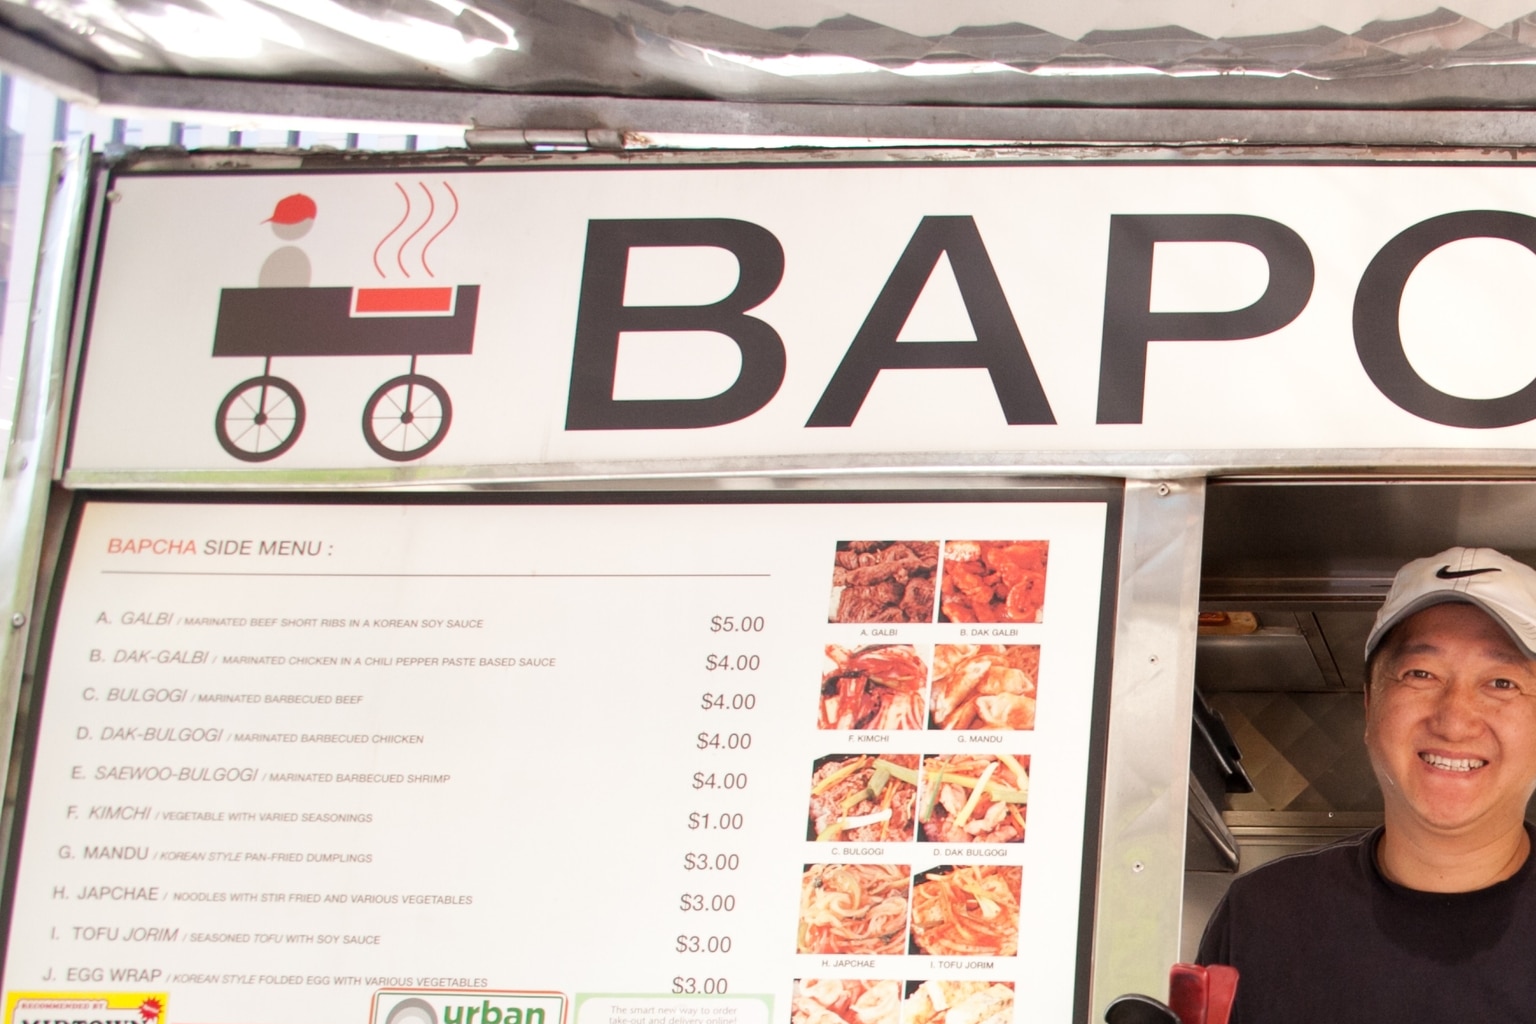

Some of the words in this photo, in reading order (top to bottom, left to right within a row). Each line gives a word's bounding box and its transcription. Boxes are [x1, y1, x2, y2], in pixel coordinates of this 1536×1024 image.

[106, 537, 197, 555] BAPCHA
[203, 539, 253, 556] SIDE
[258, 540, 322, 556] MENU
[95, 611, 112, 624] A.
[120, 611, 174, 626] GALBI
[184, 617, 248, 627] MARINATED
[249, 618, 278, 627] BEEF
[280, 618, 318, 627] SHORT
[320, 618, 346, 628] RIBS
[348, 619, 360, 628] IN
[362, 619, 370, 627] A
[373, 619, 419, 628] KOREAN
[421, 619, 444, 628] SOY
[446, 619, 484, 629] SAUCE
[710, 615, 765, 633] $5.00
[871, 628, 898, 636] GALBI
[705, 653, 760, 671] $4.00
[81, 687, 99, 701] C.
[106, 687, 188, 703] BULGOGI
[197, 694, 262, 704] MARINATED
[264, 694, 333, 704] BARBECUED
[335, 695, 364, 704] BEEF
[701, 692, 756, 711] $4.00
[75, 725, 93, 740] D.
[99, 726, 224, 742] DAK-BULGOGI
[234, 733, 298, 743] MARINATED
[300, 733, 370, 744] BARBECUED
[696, 732, 752, 750] $4.00
[70, 765, 86, 780] E.
[94, 765, 259, 782] SAEWOO-BULGOGI
[269, 773, 333, 783] MARINATED
[335, 773, 405, 783] BARBECUED
[407, 774, 451, 783] SHRIMP
[692, 771, 747, 790] $4.00
[66, 804, 78, 820] F.
[88, 805, 152, 821] KIMCHI
[162, 811, 224, 821] VEGETABLE
[228, 812, 256, 821] WITH
[259, 812, 299, 822] VARIED
[301, 813, 373, 823] SEASONINGS
[688, 811, 743, 830] $1.00
[683, 852, 739, 871] $3.00
[680, 893, 735, 912] $3.00
[675, 934, 732, 953] $3.00
